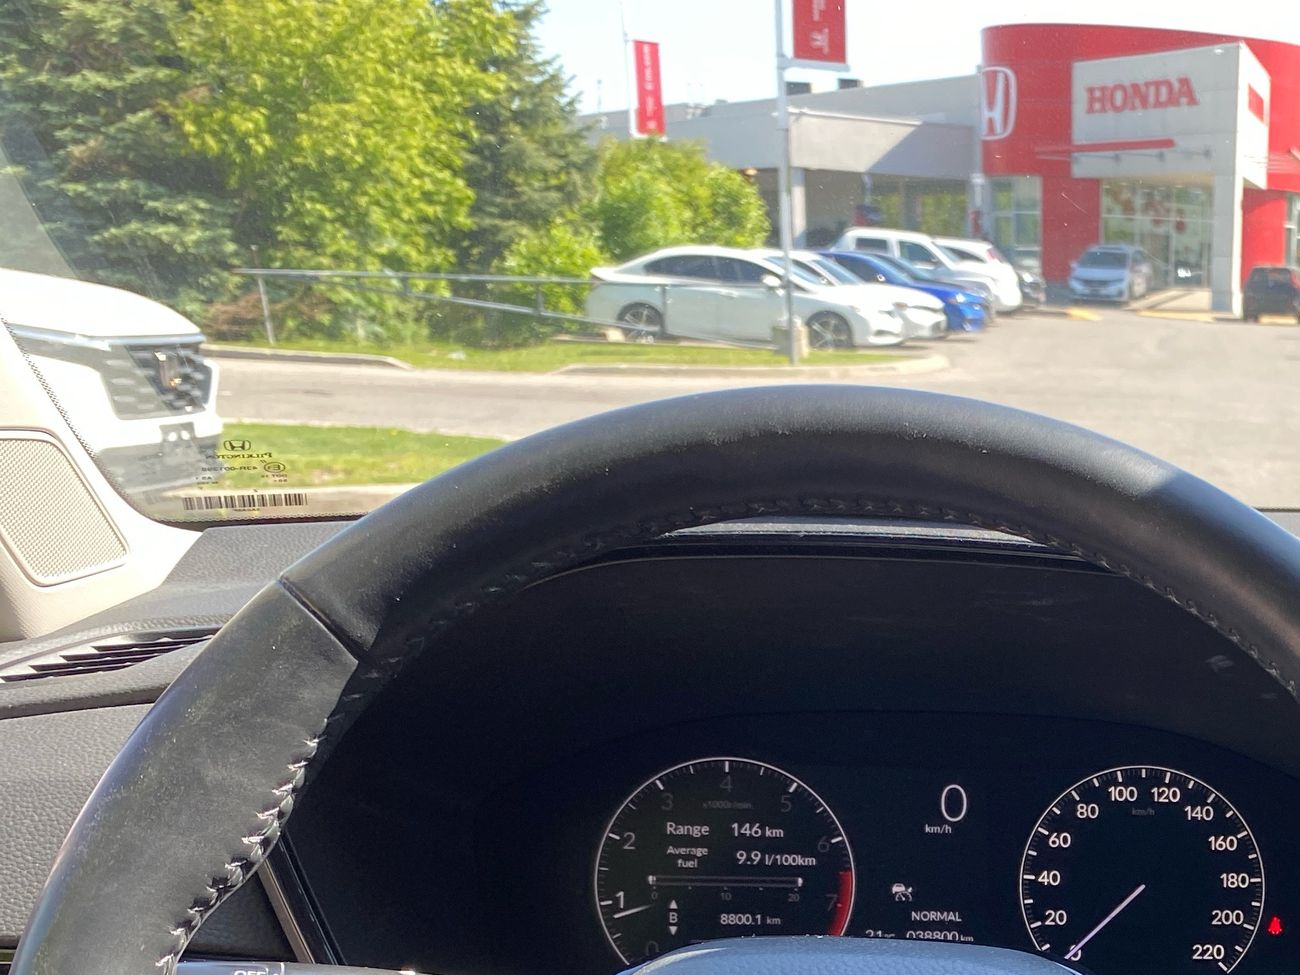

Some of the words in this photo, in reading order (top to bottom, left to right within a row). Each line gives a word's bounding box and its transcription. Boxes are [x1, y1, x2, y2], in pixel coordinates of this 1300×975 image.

[1086, 77, 1200, 114] HONDA
[719, 776, 733, 792] 4
[661, 793, 674, 811] 3
[1107, 786, 1138, 802] 100
[1151, 787, 1181, 803] 120
[780, 794, 793, 812] 5
[940, 783, 968, 822] 0
[1076, 804, 1099, 819] 80
[1184, 806, 1214, 821] 140
[666, 822, 710, 837] Range
[731, 822, 762, 837] 146
[765, 826, 784, 838] km
[925, 823, 952, 835] km/h
[623, 832, 636, 850] 2
[817, 836, 830, 852] 6
[1048, 833, 1071, 848] 60
[1208, 836, 1238, 852] 160
[666, 845, 709, 857] Average
[736, 850, 761, 865] 9.9
[677, 857, 698, 868] fuel
[1038, 870, 1061, 886] 40
[1220, 873, 1250, 888] 180
[615, 891, 625, 908] 1
[720, 914, 762, 926] 8800.1
[766, 916, 781, 926] km
[911, 911, 962, 921] NORMAL
[1044, 909, 1067, 925] 20
[1211, 910, 1244, 926] 200
[1192, 944, 1225, 961] 220
